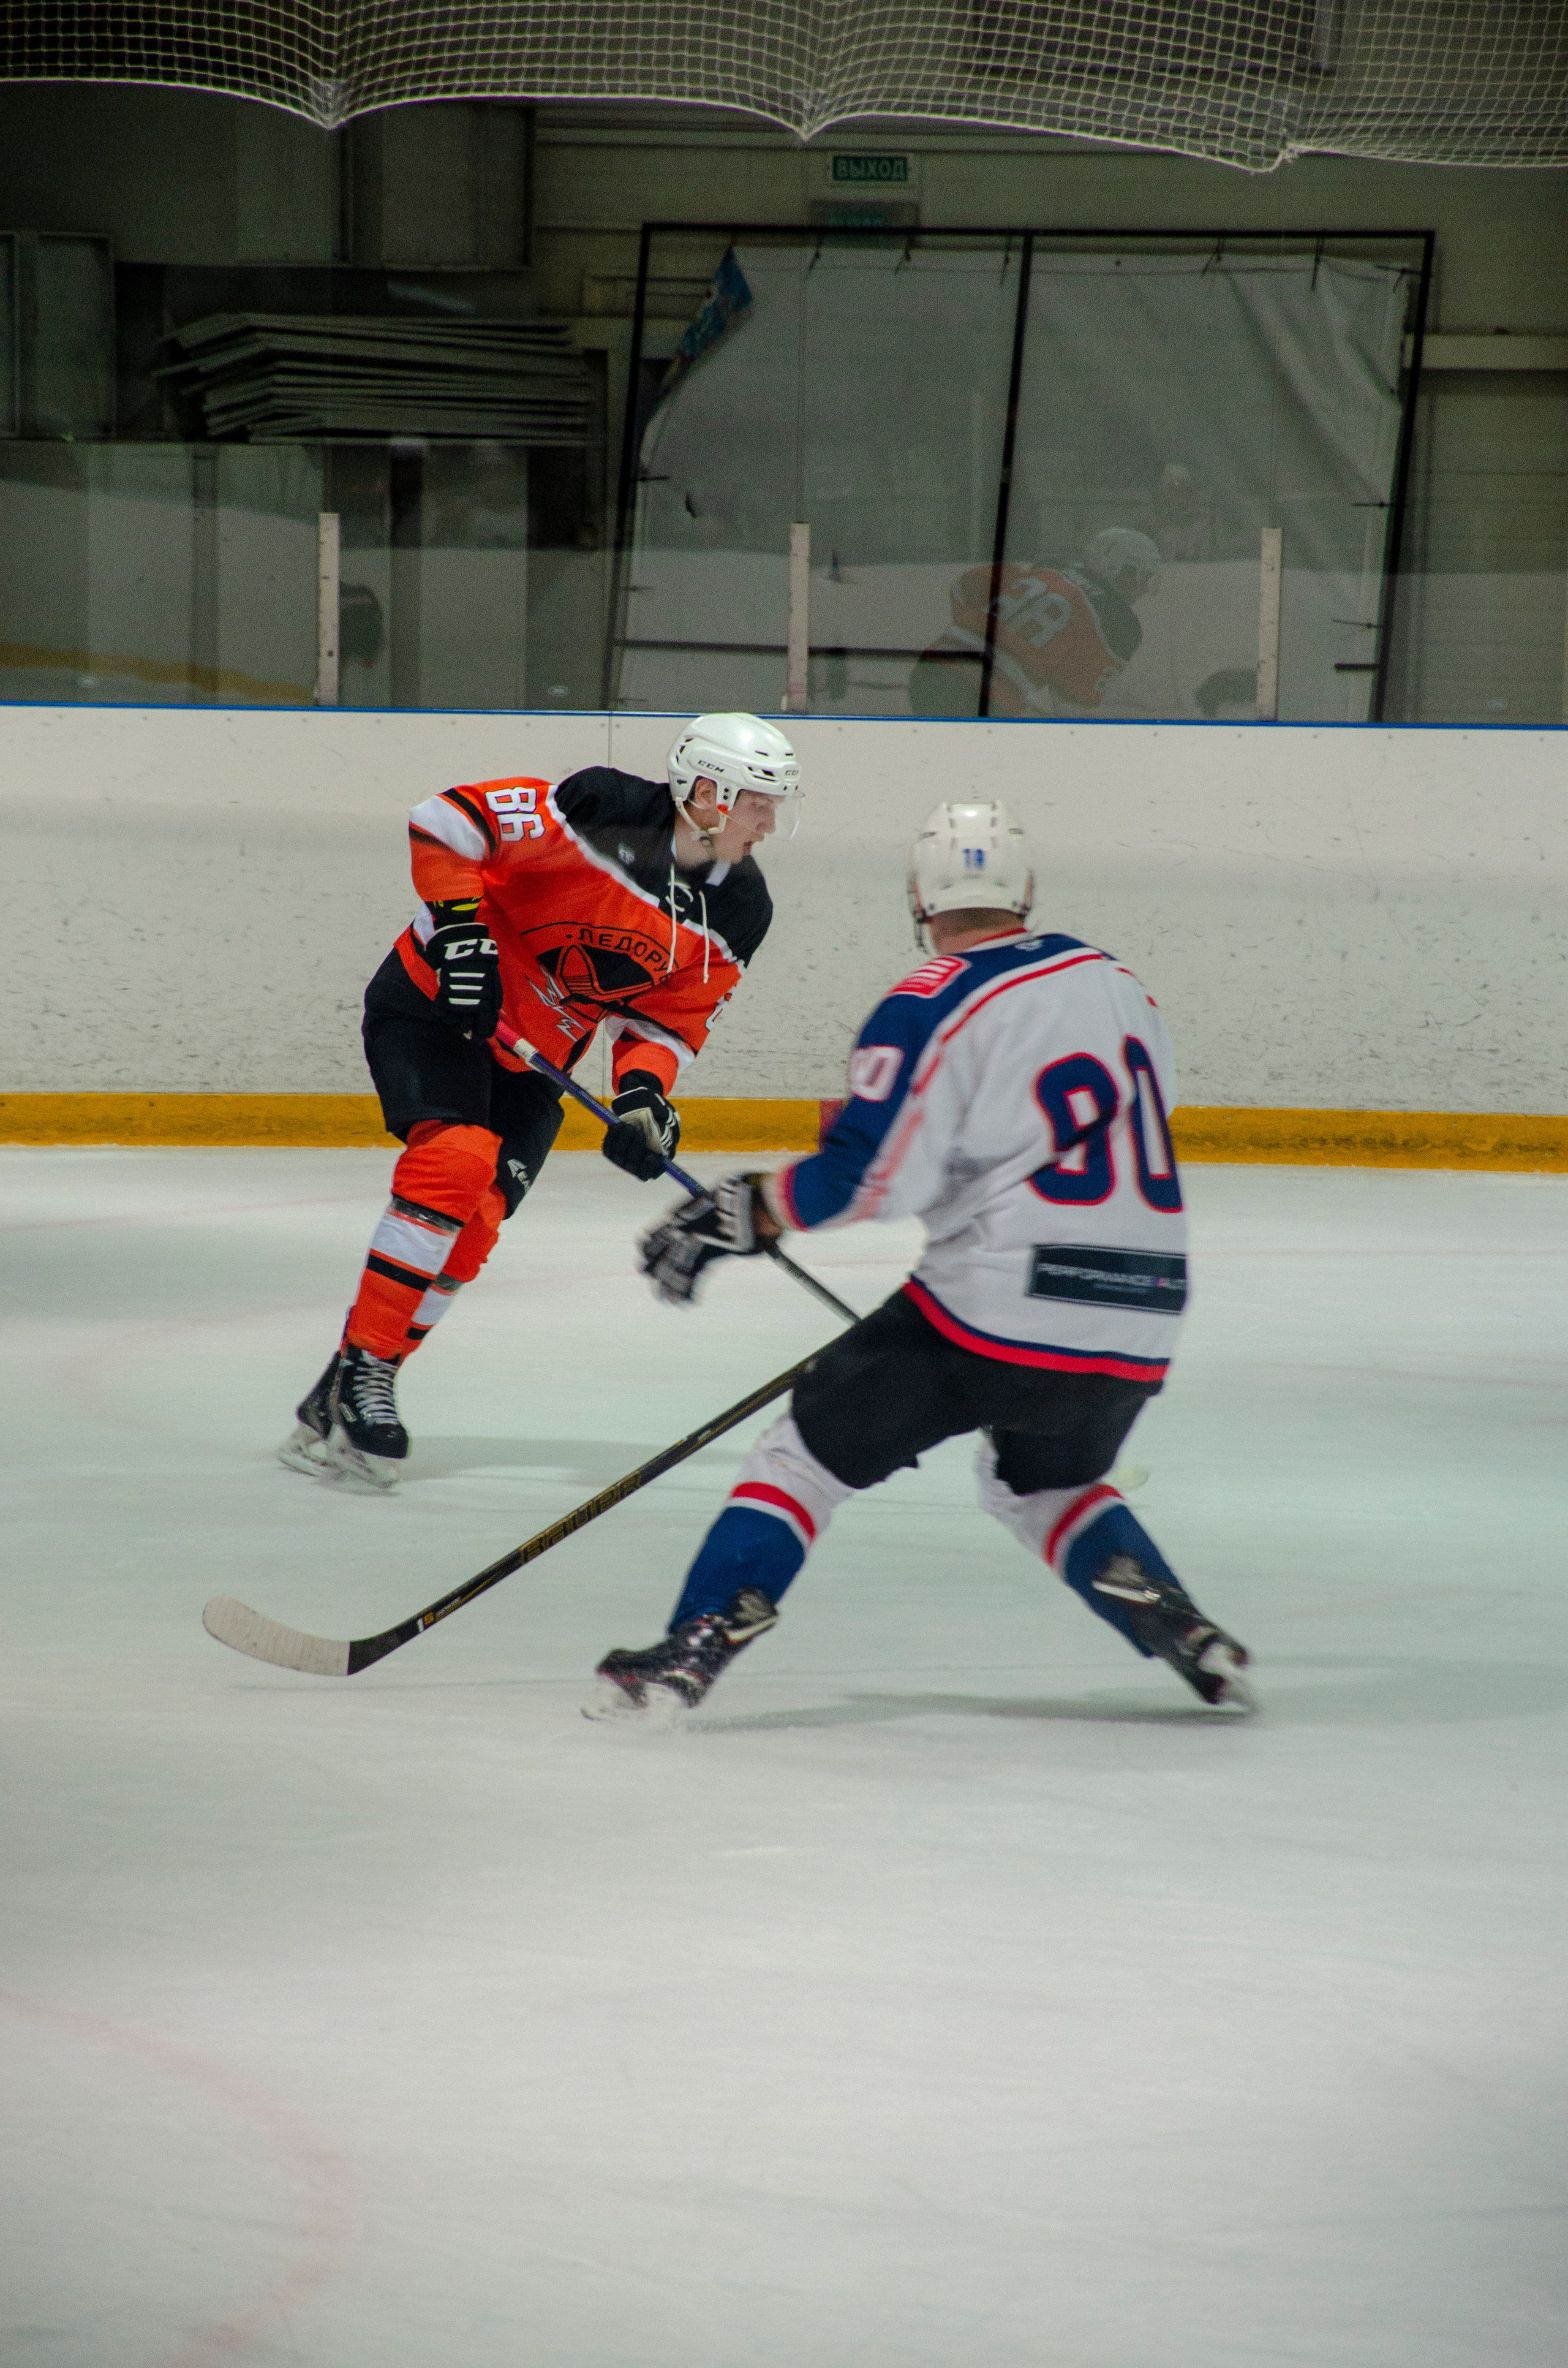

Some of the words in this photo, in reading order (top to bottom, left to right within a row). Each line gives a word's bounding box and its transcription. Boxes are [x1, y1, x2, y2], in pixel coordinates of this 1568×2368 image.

[836, 159, 905, 180] ВЫХОД
[698, 760, 725, 773] CCM
[1025, 1032, 1185, 1214] 90
